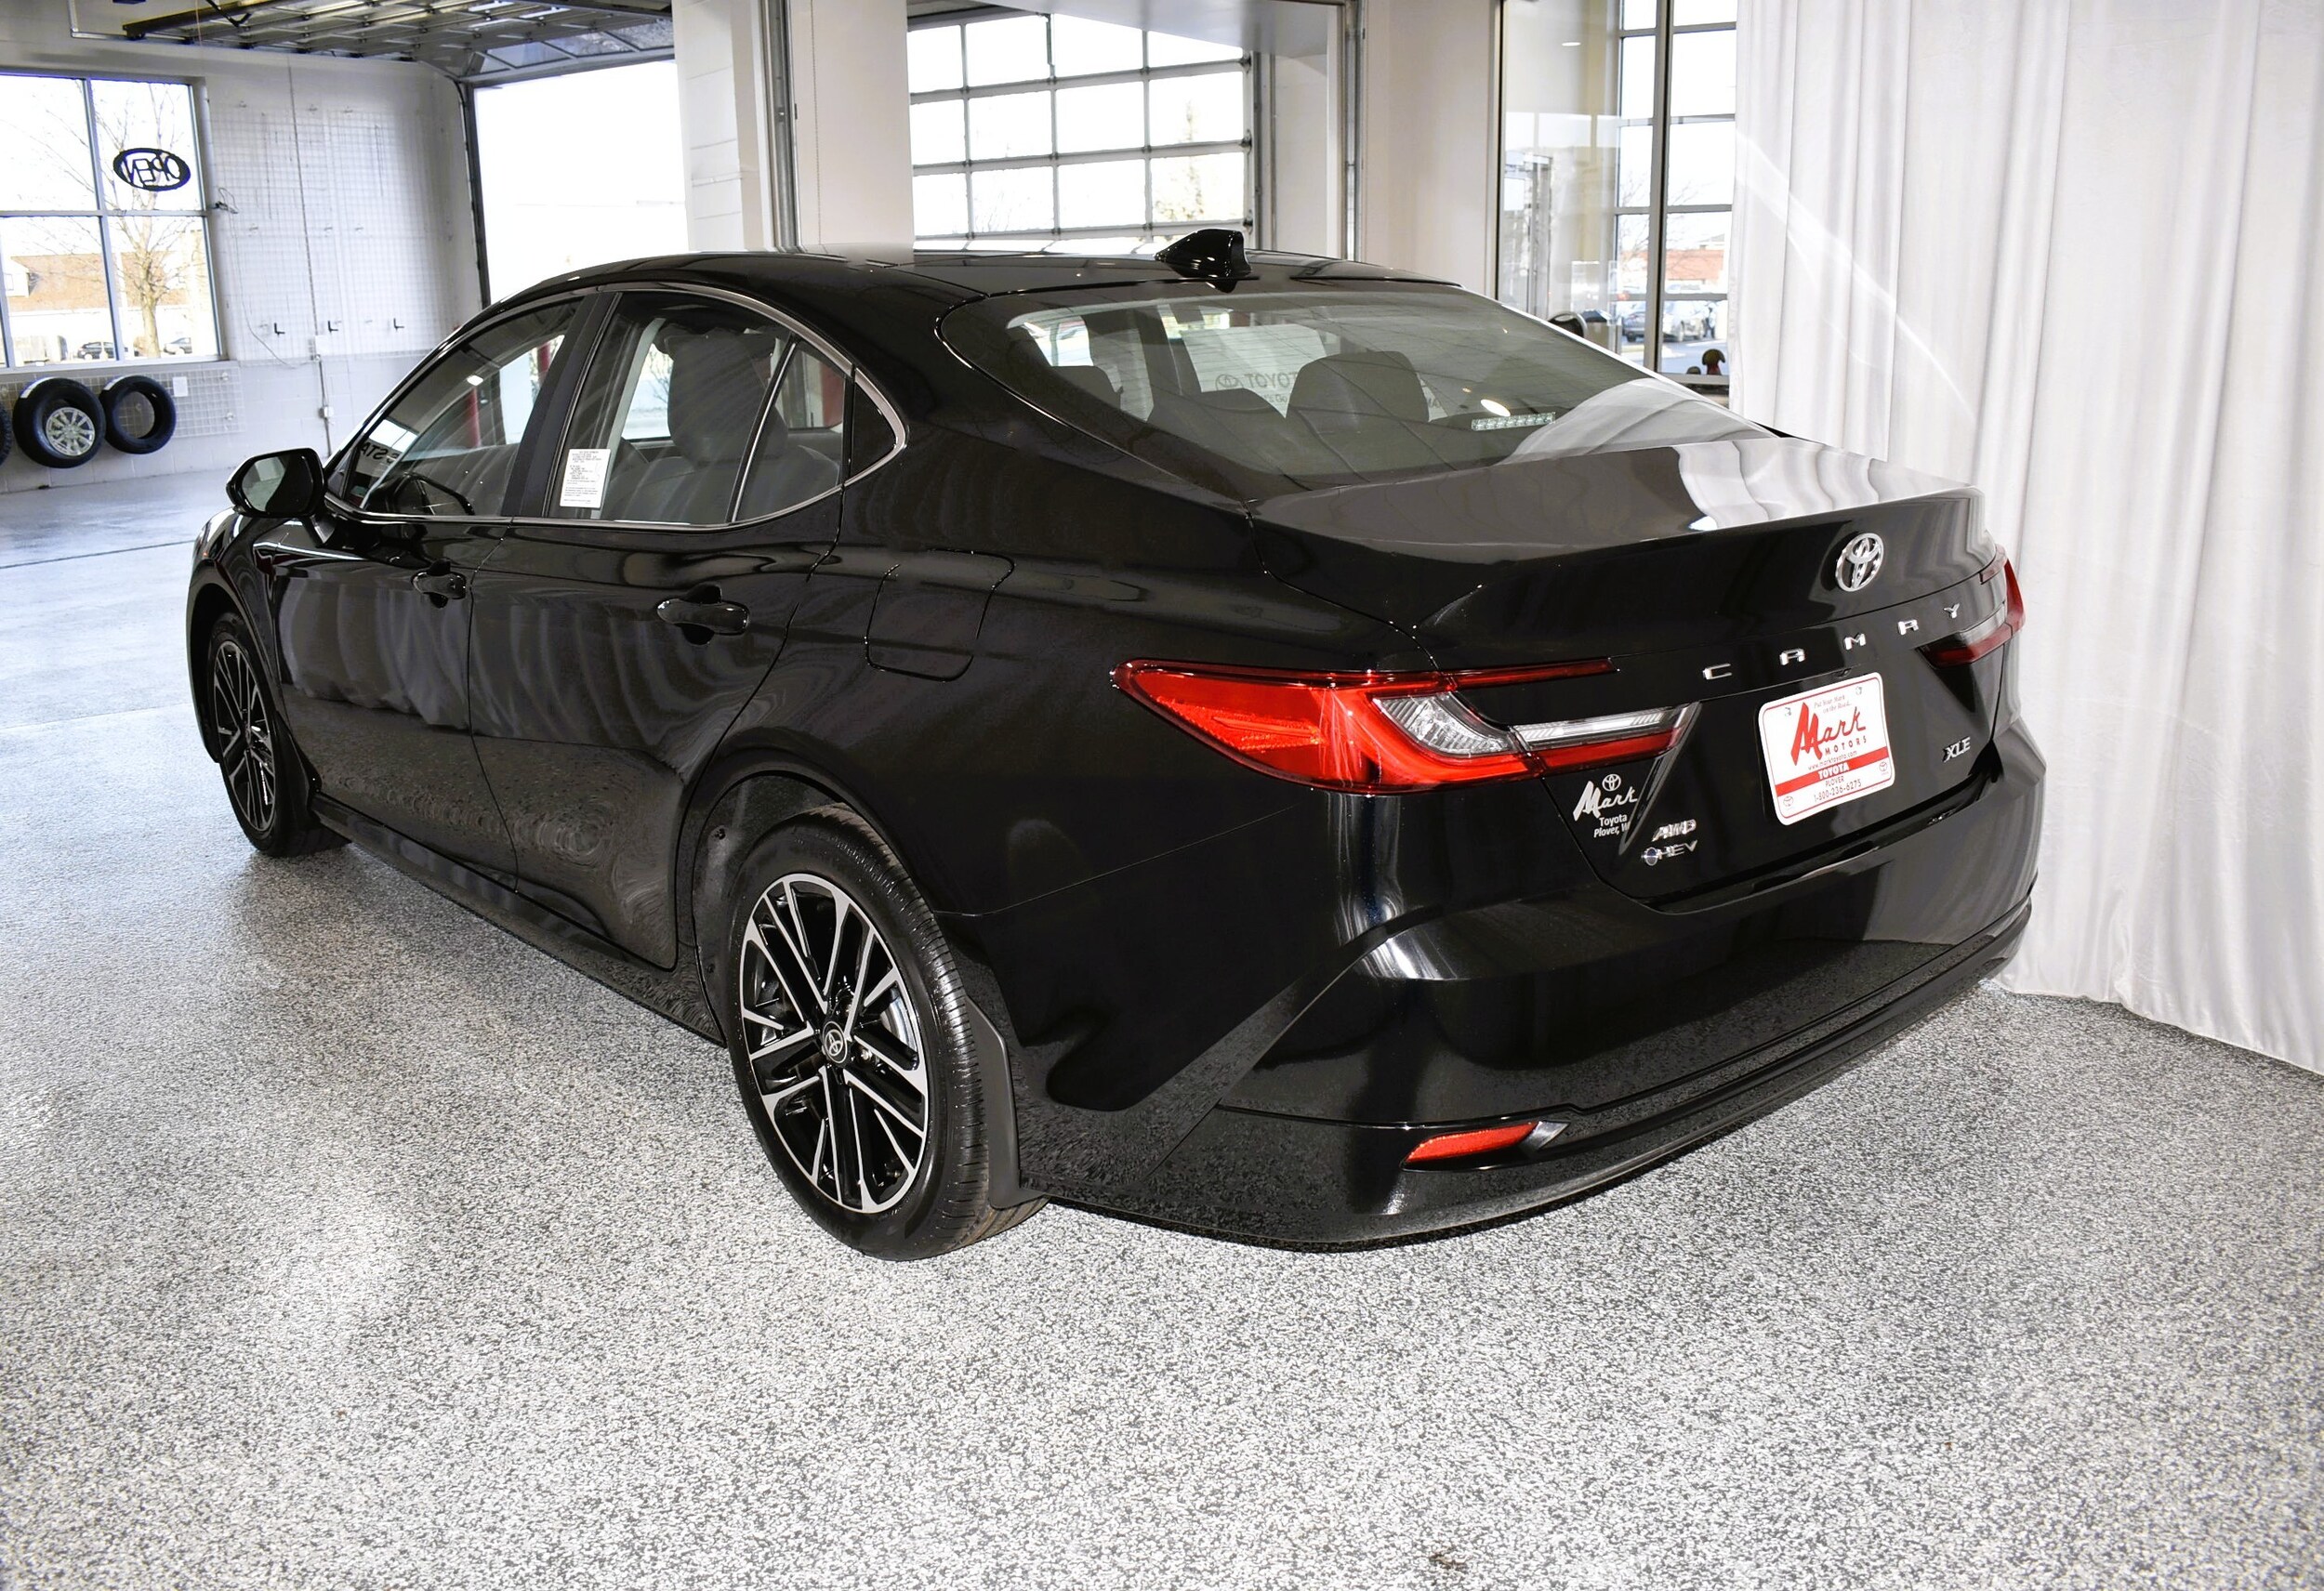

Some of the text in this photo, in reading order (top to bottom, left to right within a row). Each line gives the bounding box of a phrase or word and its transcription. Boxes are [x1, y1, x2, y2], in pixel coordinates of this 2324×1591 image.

[1243, 372, 1299, 388] TOYOT
[1703, 603, 1961, 680] CAMRY
[1790, 702, 1867, 766] Mark
[1824, 735, 1867, 756] MOTORS
[1942, 736, 1971, 763] XLE
[1807, 750, 1858, 770] www.marktoyota.com
[1817, 762, 1850, 780] TOYOTA
[1825, 775, 1845, 787] PLOVER
[1573, 781, 1638, 822] Mark
[1599, 814, 1628, 827] Toyota
[1651, 819, 1697, 842] AWD
[1593, 825, 1620, 838] Plover,
[1656, 839, 1698, 861] HEV
